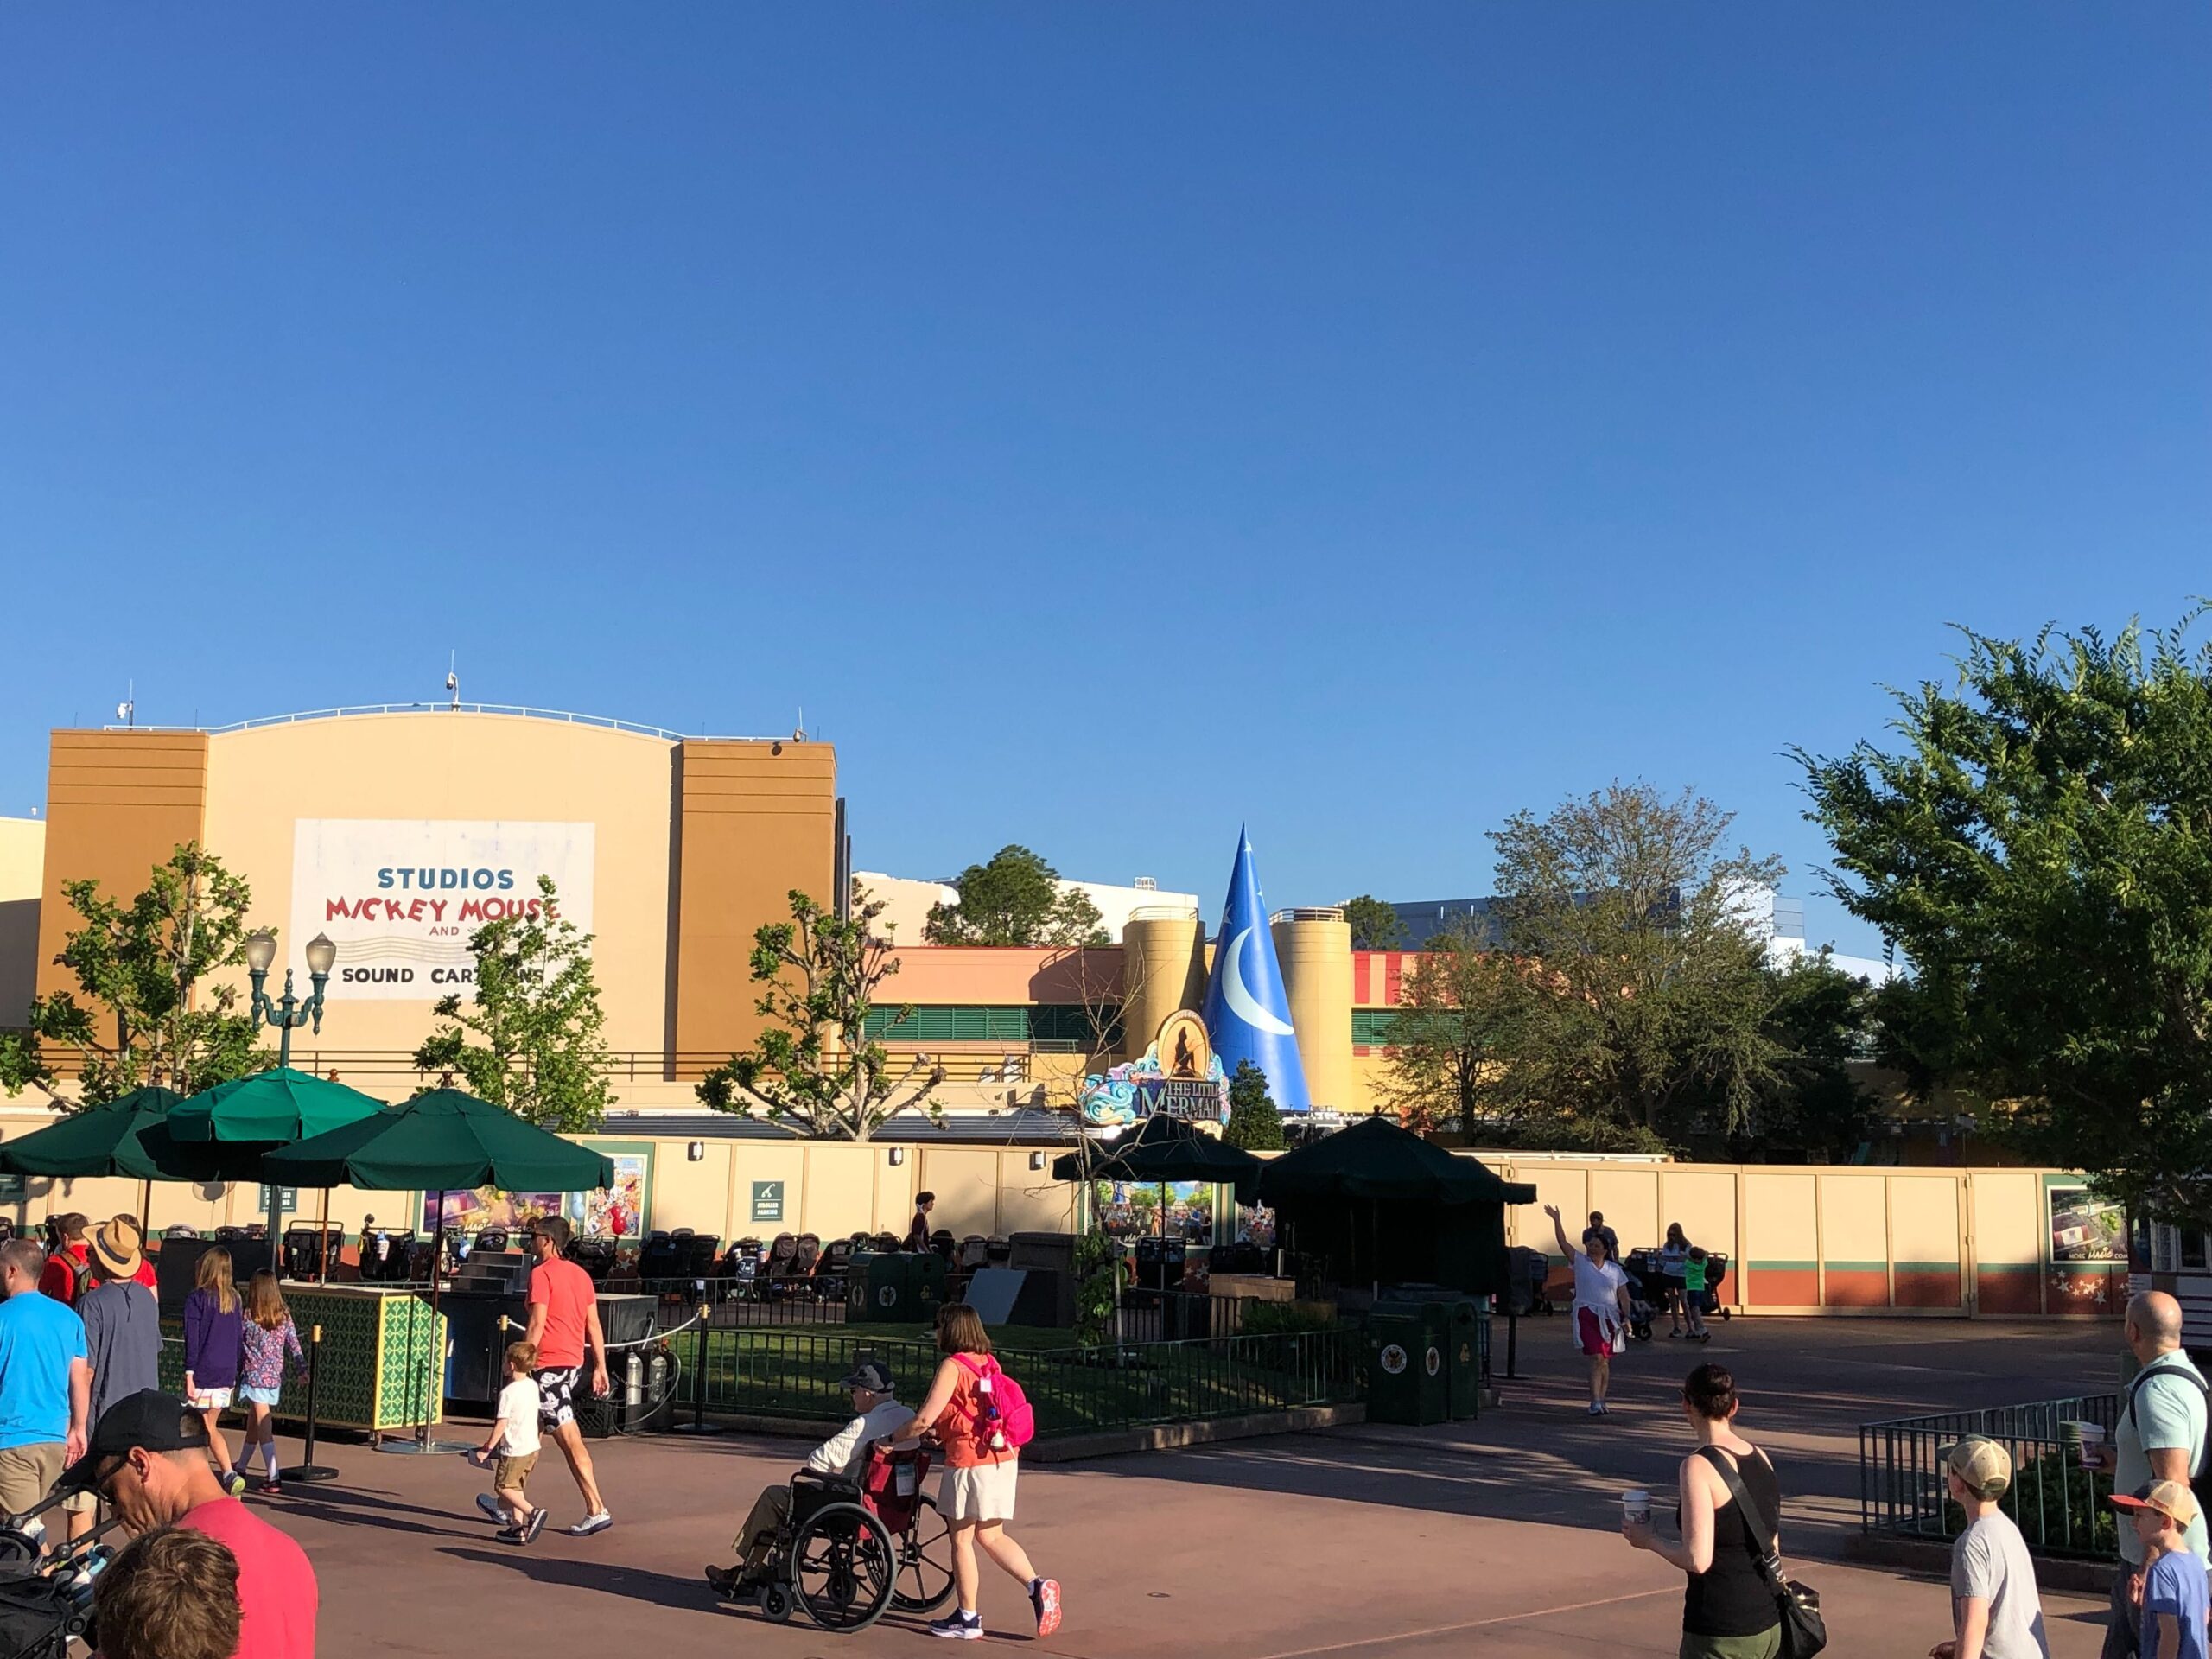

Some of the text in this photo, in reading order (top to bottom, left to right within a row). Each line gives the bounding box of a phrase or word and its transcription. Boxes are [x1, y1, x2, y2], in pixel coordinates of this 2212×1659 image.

[378, 868, 514, 890] STUDIOS
[326, 895, 448, 922] MICKEY
[429, 926, 460, 936] AND
[342, 968, 414, 983] SOUND
[1166, 1082, 1191, 1096] THE
[2088, 1247, 2113, 1260] MAGIC
